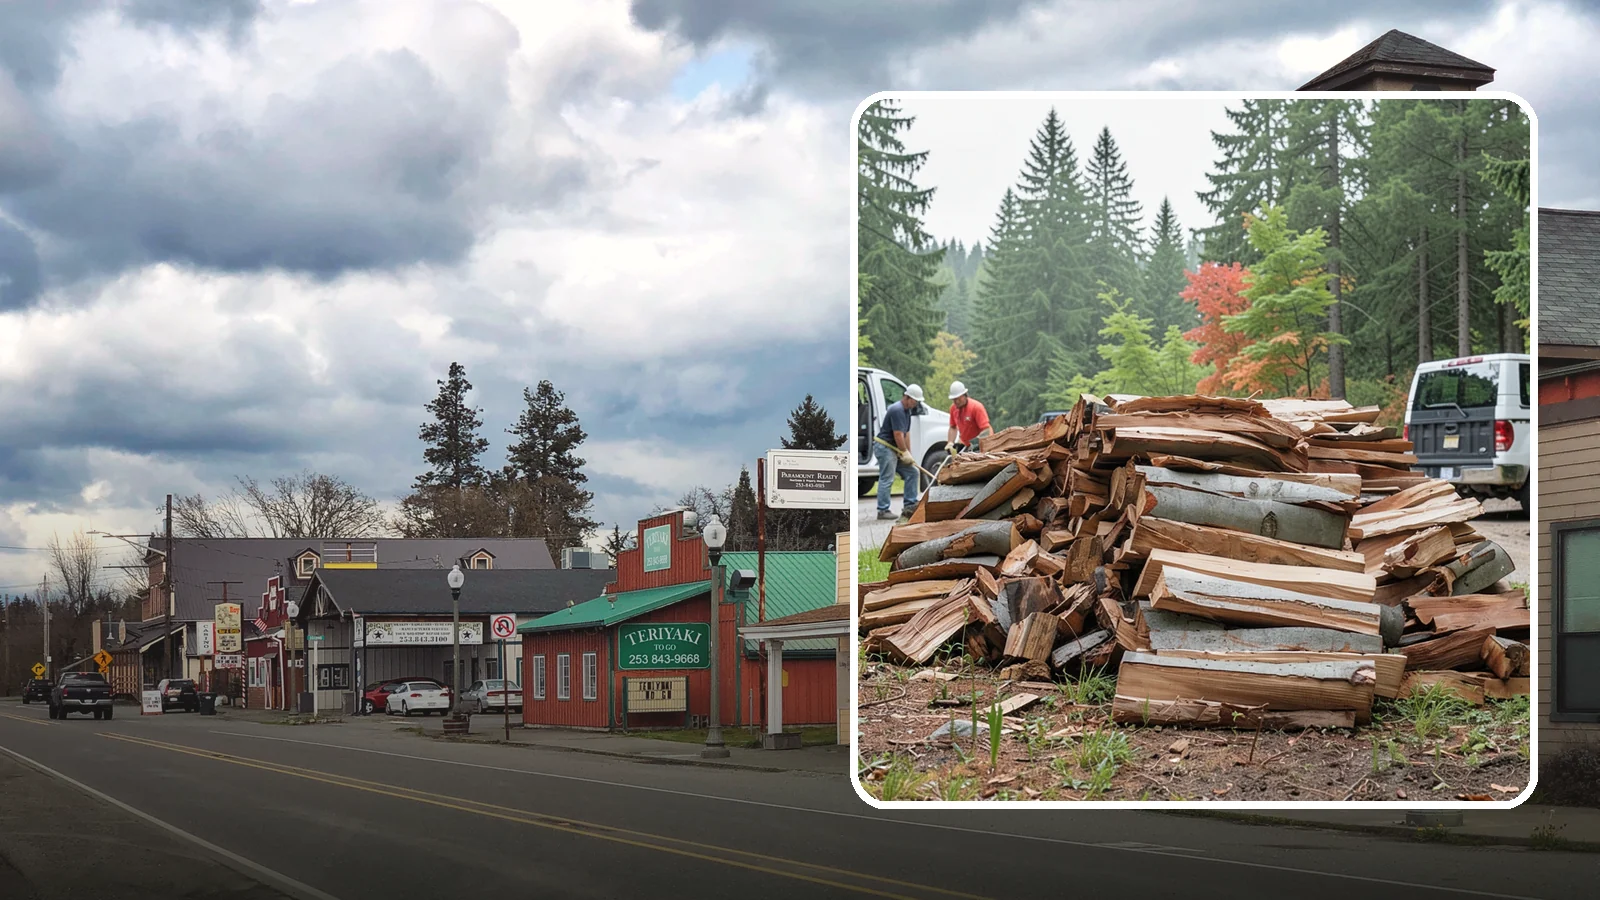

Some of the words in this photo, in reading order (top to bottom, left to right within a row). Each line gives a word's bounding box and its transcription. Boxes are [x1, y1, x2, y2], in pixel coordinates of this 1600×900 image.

[624, 627, 702, 646] TERIYAKI
[628, 654, 648, 665] 253
[651, 653, 700, 664] 843-9668
